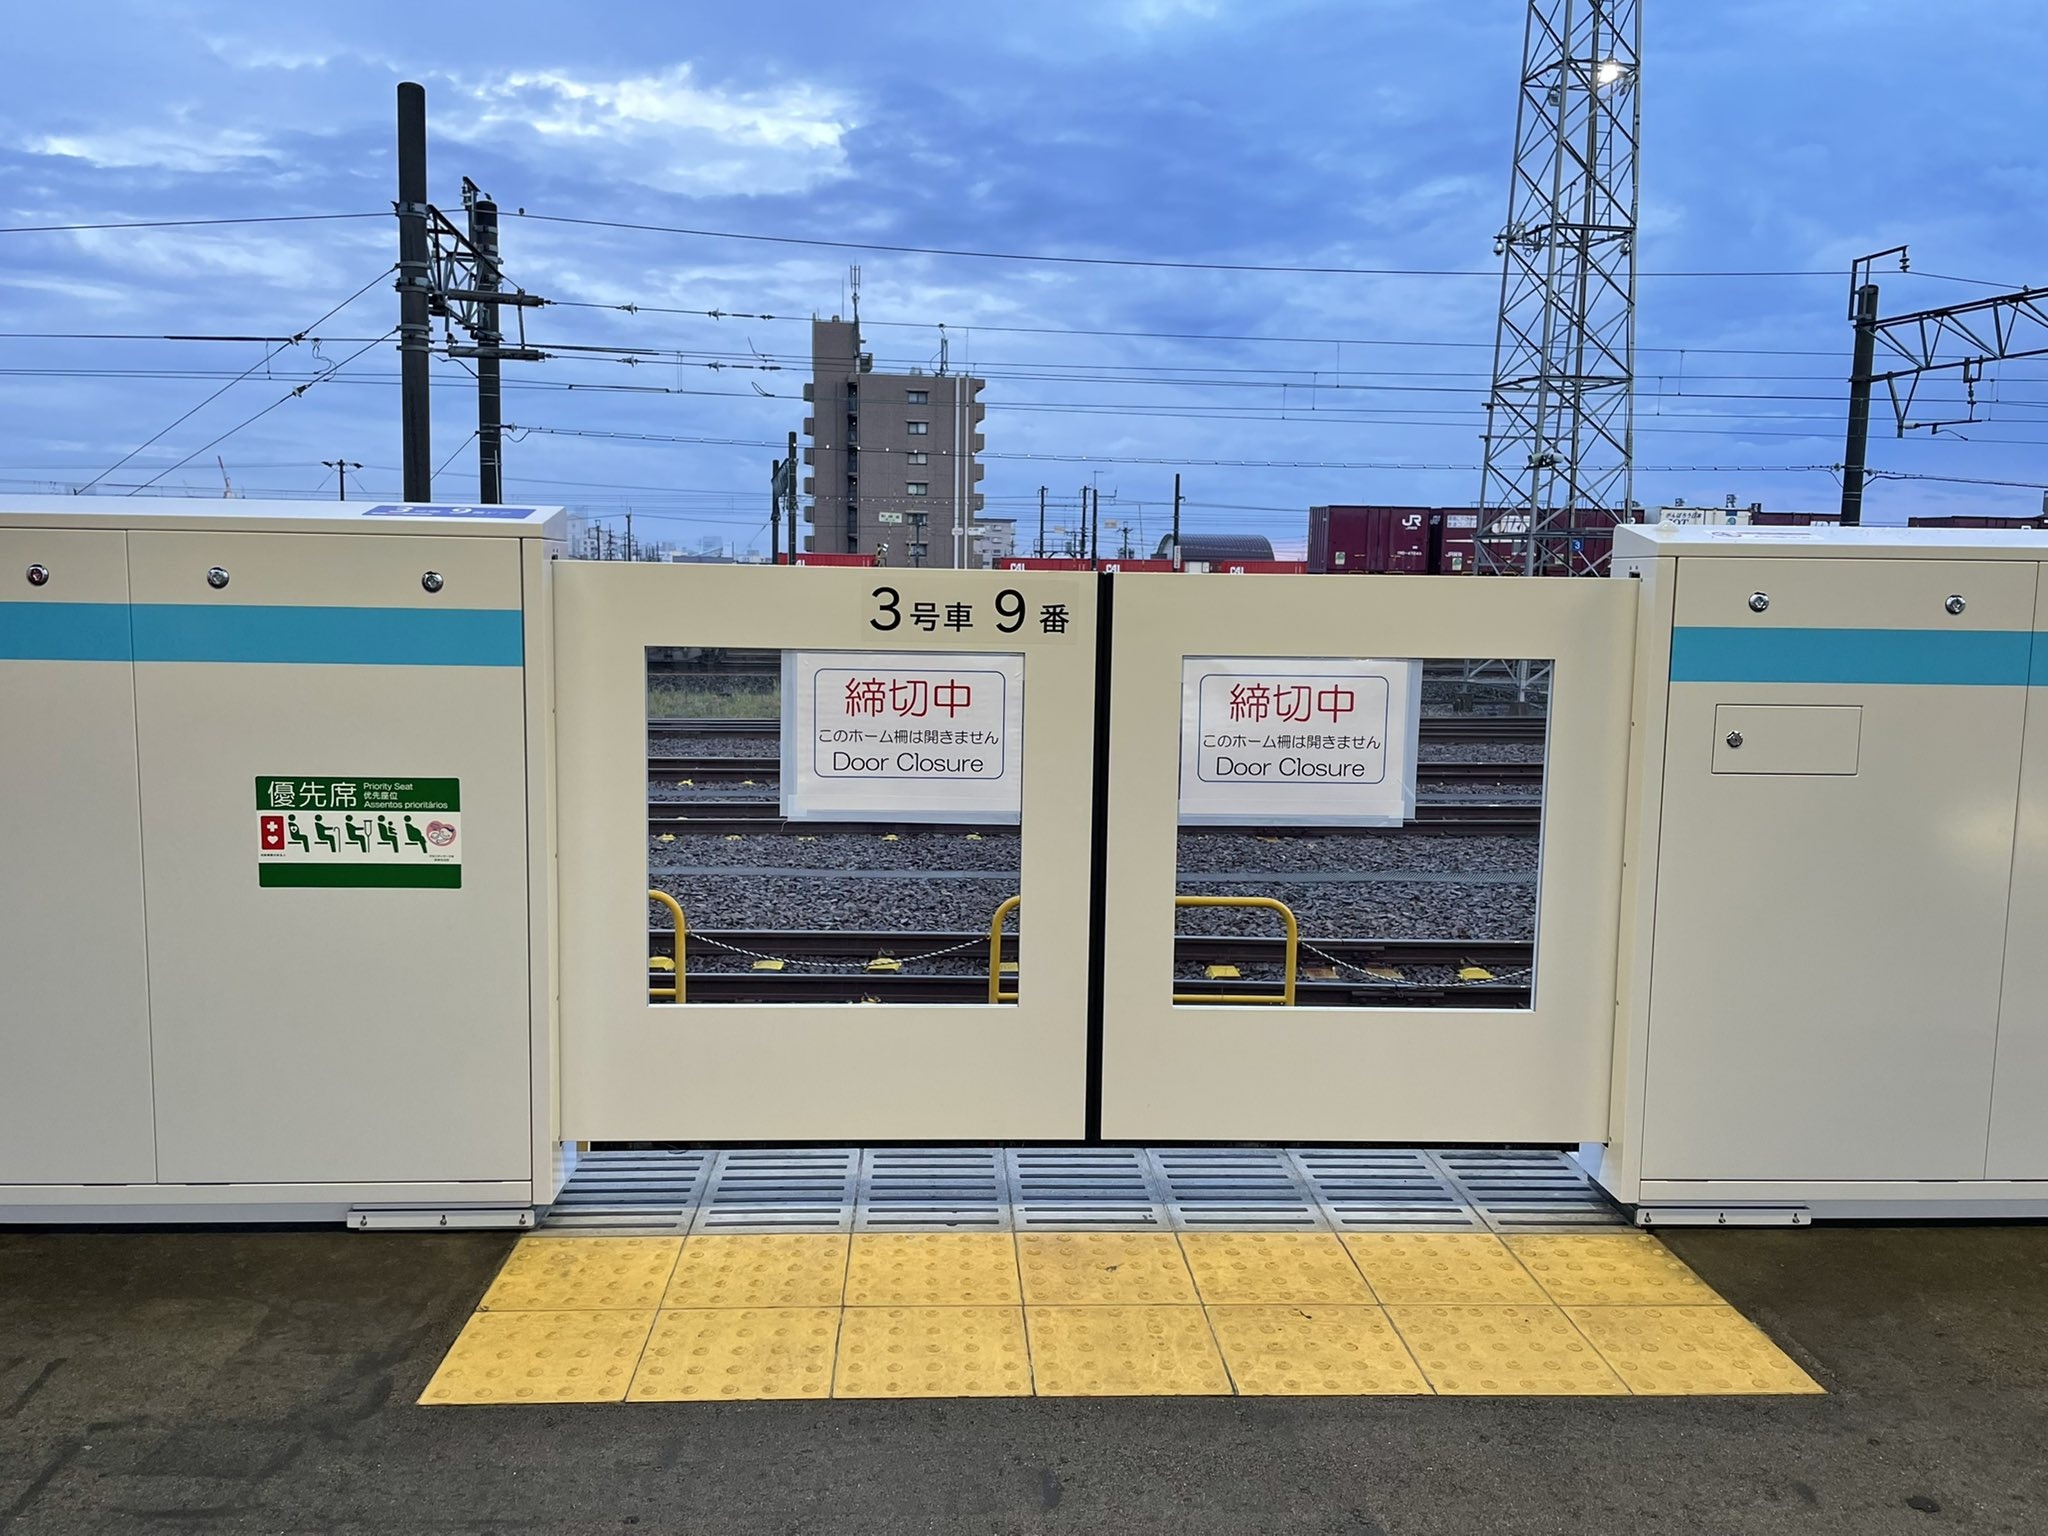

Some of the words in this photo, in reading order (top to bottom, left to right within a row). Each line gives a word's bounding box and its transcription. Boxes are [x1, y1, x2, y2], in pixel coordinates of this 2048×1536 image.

[1402, 514, 1422, 526] JR
[1574, 541, 1581, 550] 3
[870, 587, 973, 631] 3号車
[995, 589, 1069, 634] 9番
[845, 677, 971, 719] 締切中
[1230, 683, 1355, 724] 締切中
[818, 729, 999, 745] このホーム柵は開きません
[1203, 734, 1381, 750] このホーム柵は開きません
[833, 751, 889, 771] Door
[897, 752, 984, 773] Closure
[1216, 756, 1272, 776] Door
[1279, 757, 1365, 777] Closure
[268, 780, 357, 808] 優先席
[363, 782, 393, 791] Priority
[394, 782, 413, 791] Seat
[364, 800, 403, 809] Assentos
[404, 800, 448, 810] prioritários
